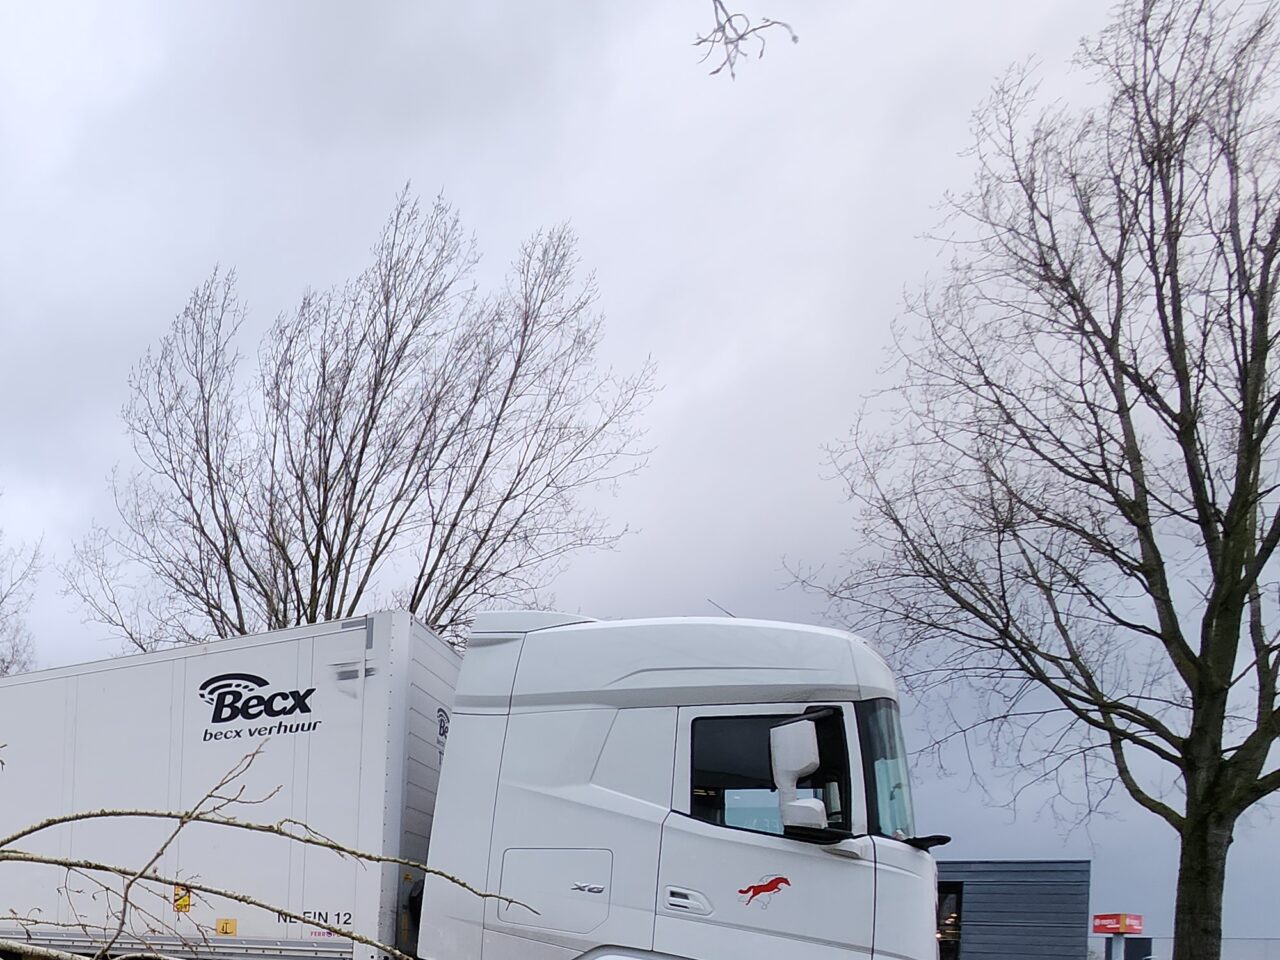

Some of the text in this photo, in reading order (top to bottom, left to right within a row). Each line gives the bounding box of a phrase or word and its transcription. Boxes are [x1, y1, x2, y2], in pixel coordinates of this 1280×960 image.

[211, 688, 316, 723] Becx
[203, 721, 322, 741] becx verhuur
[570, 883, 605, 893] XG
[334, 912, 352, 925] 12
